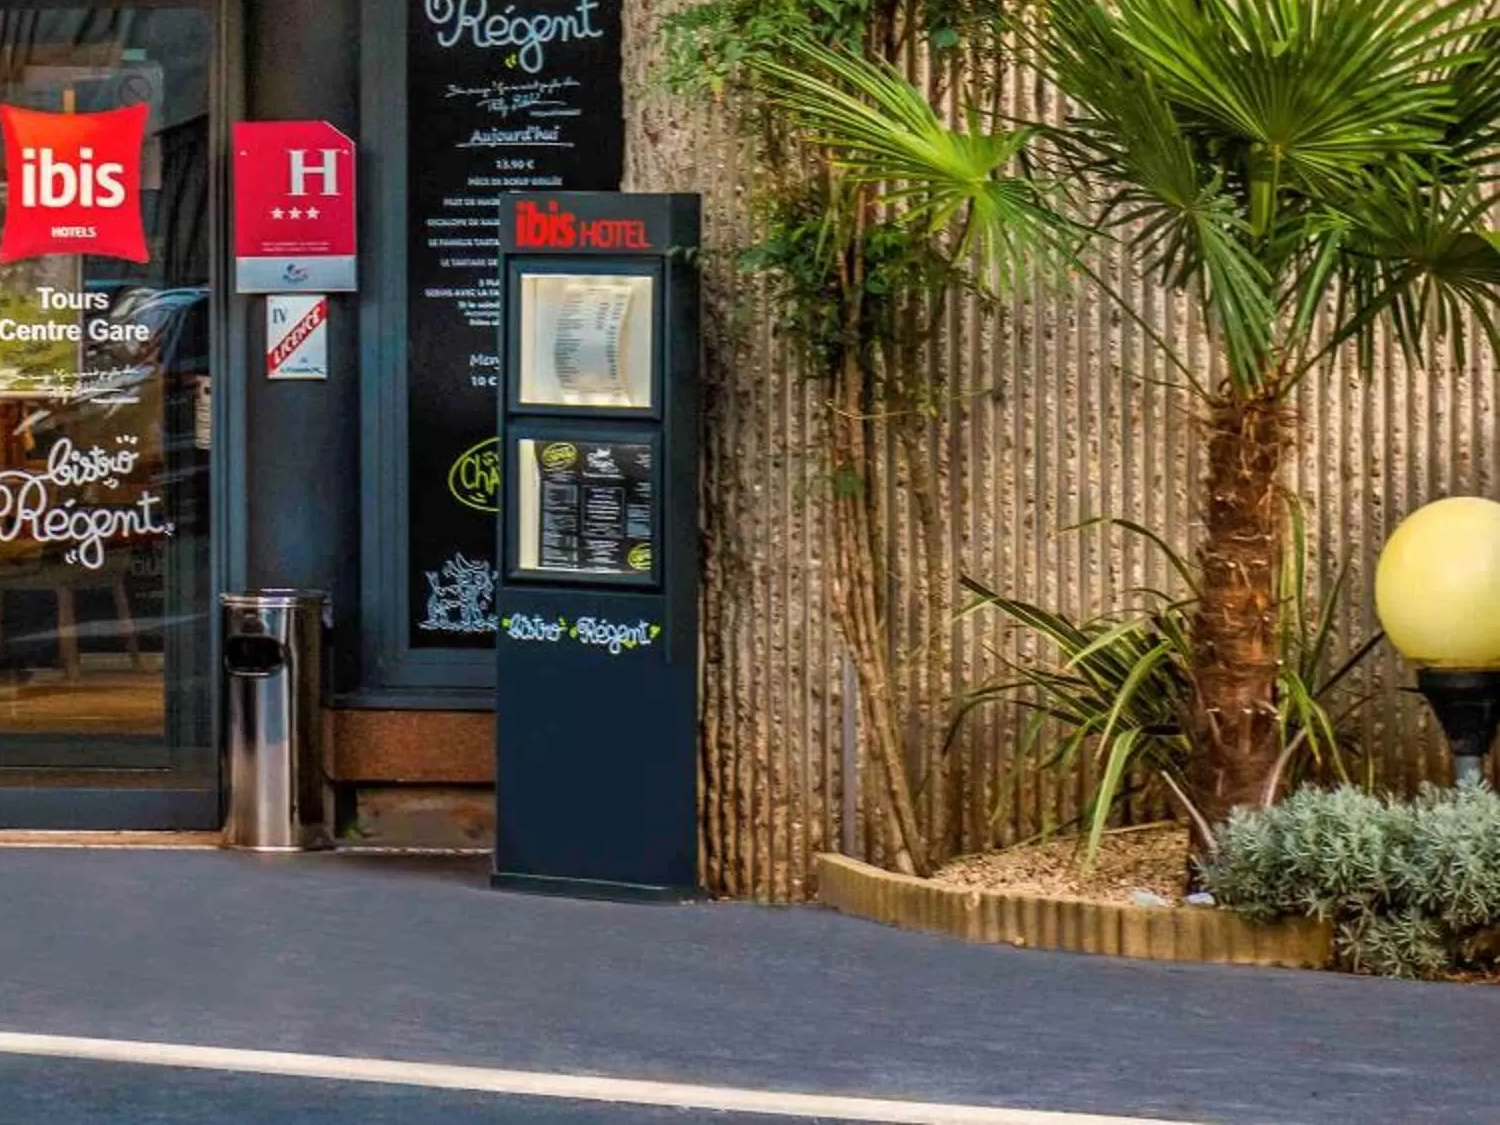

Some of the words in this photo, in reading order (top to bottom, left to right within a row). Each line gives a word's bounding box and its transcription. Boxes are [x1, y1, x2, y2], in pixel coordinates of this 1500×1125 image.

[21, 147, 126, 209] ibis
[287, 147, 343, 197] H
[51, 226, 97, 239] HOTELS
[515, 200, 577, 248] ibis
[580, 218, 653, 248] HOTEL
[37, 287, 109, 310] Tours
[272, 308, 287, 324] IV
[88, 319, 150, 342] Gare
[273, 307, 321, 364] LICENCE
[47, 438, 139, 486] bistro
[575, 616, 653, 654] Régent
